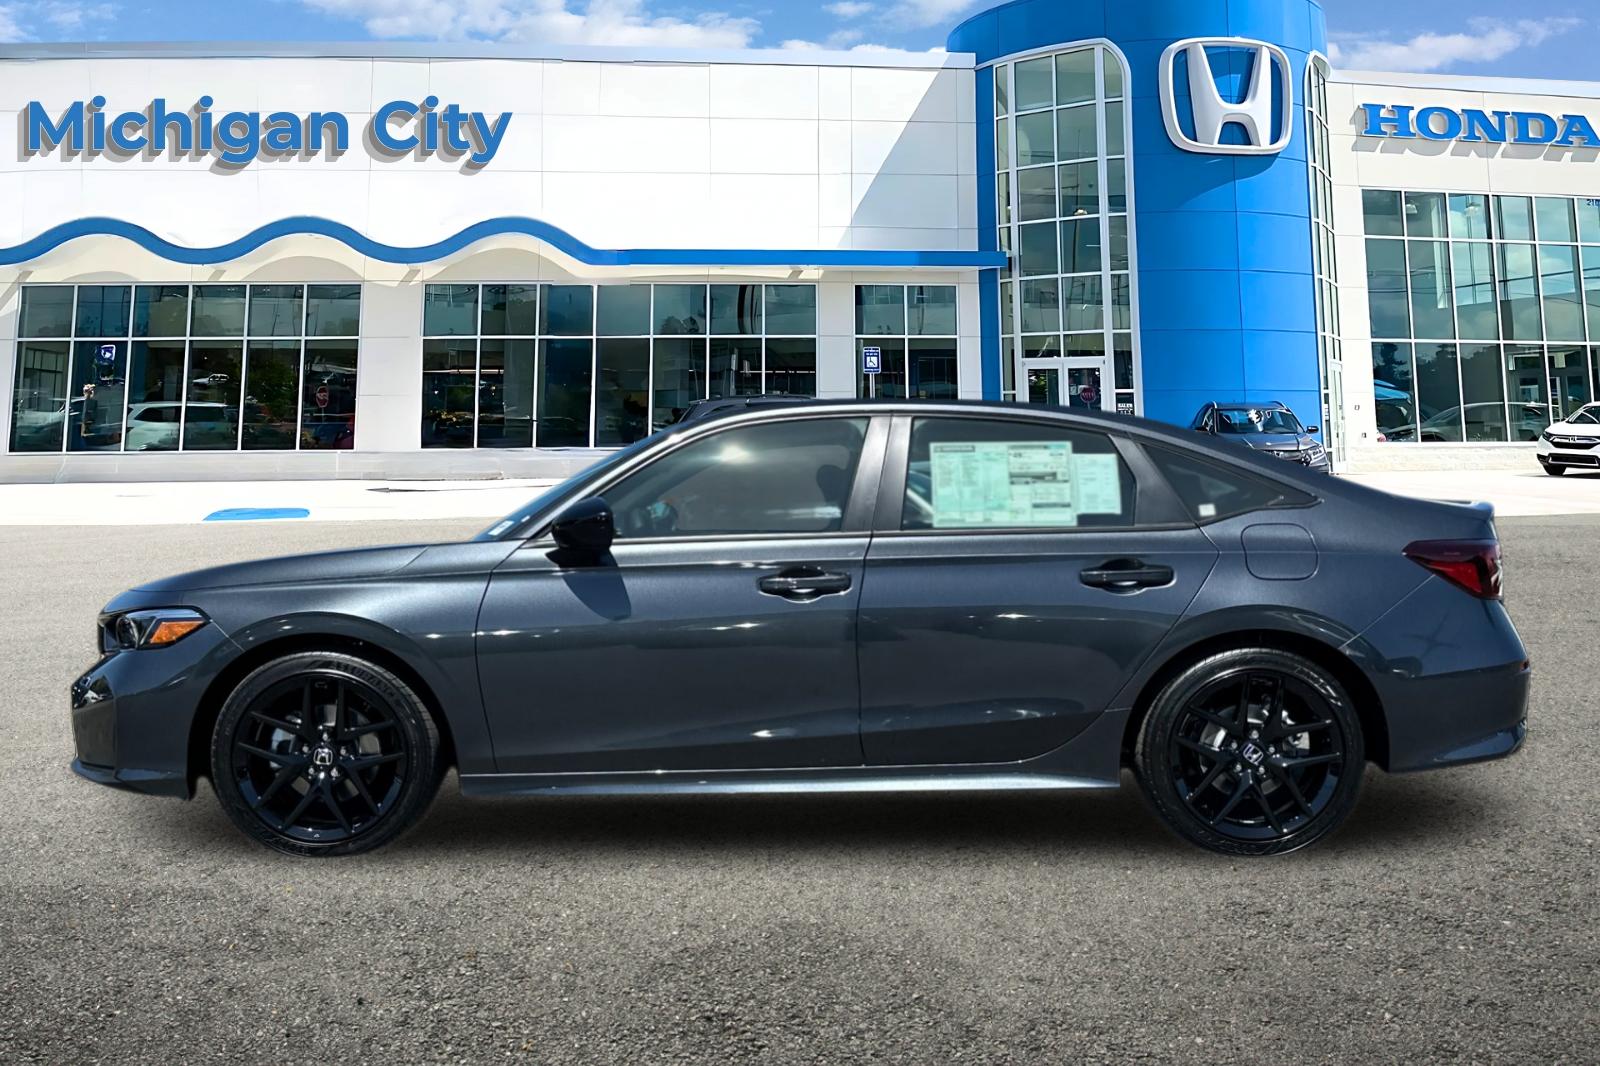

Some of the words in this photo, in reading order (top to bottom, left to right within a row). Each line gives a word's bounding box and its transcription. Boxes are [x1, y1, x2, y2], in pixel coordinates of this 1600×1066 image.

[28, 95, 349, 164] Michigan
[374, 95, 513, 164] City
[1361, 103, 1600, 147] HONDA
